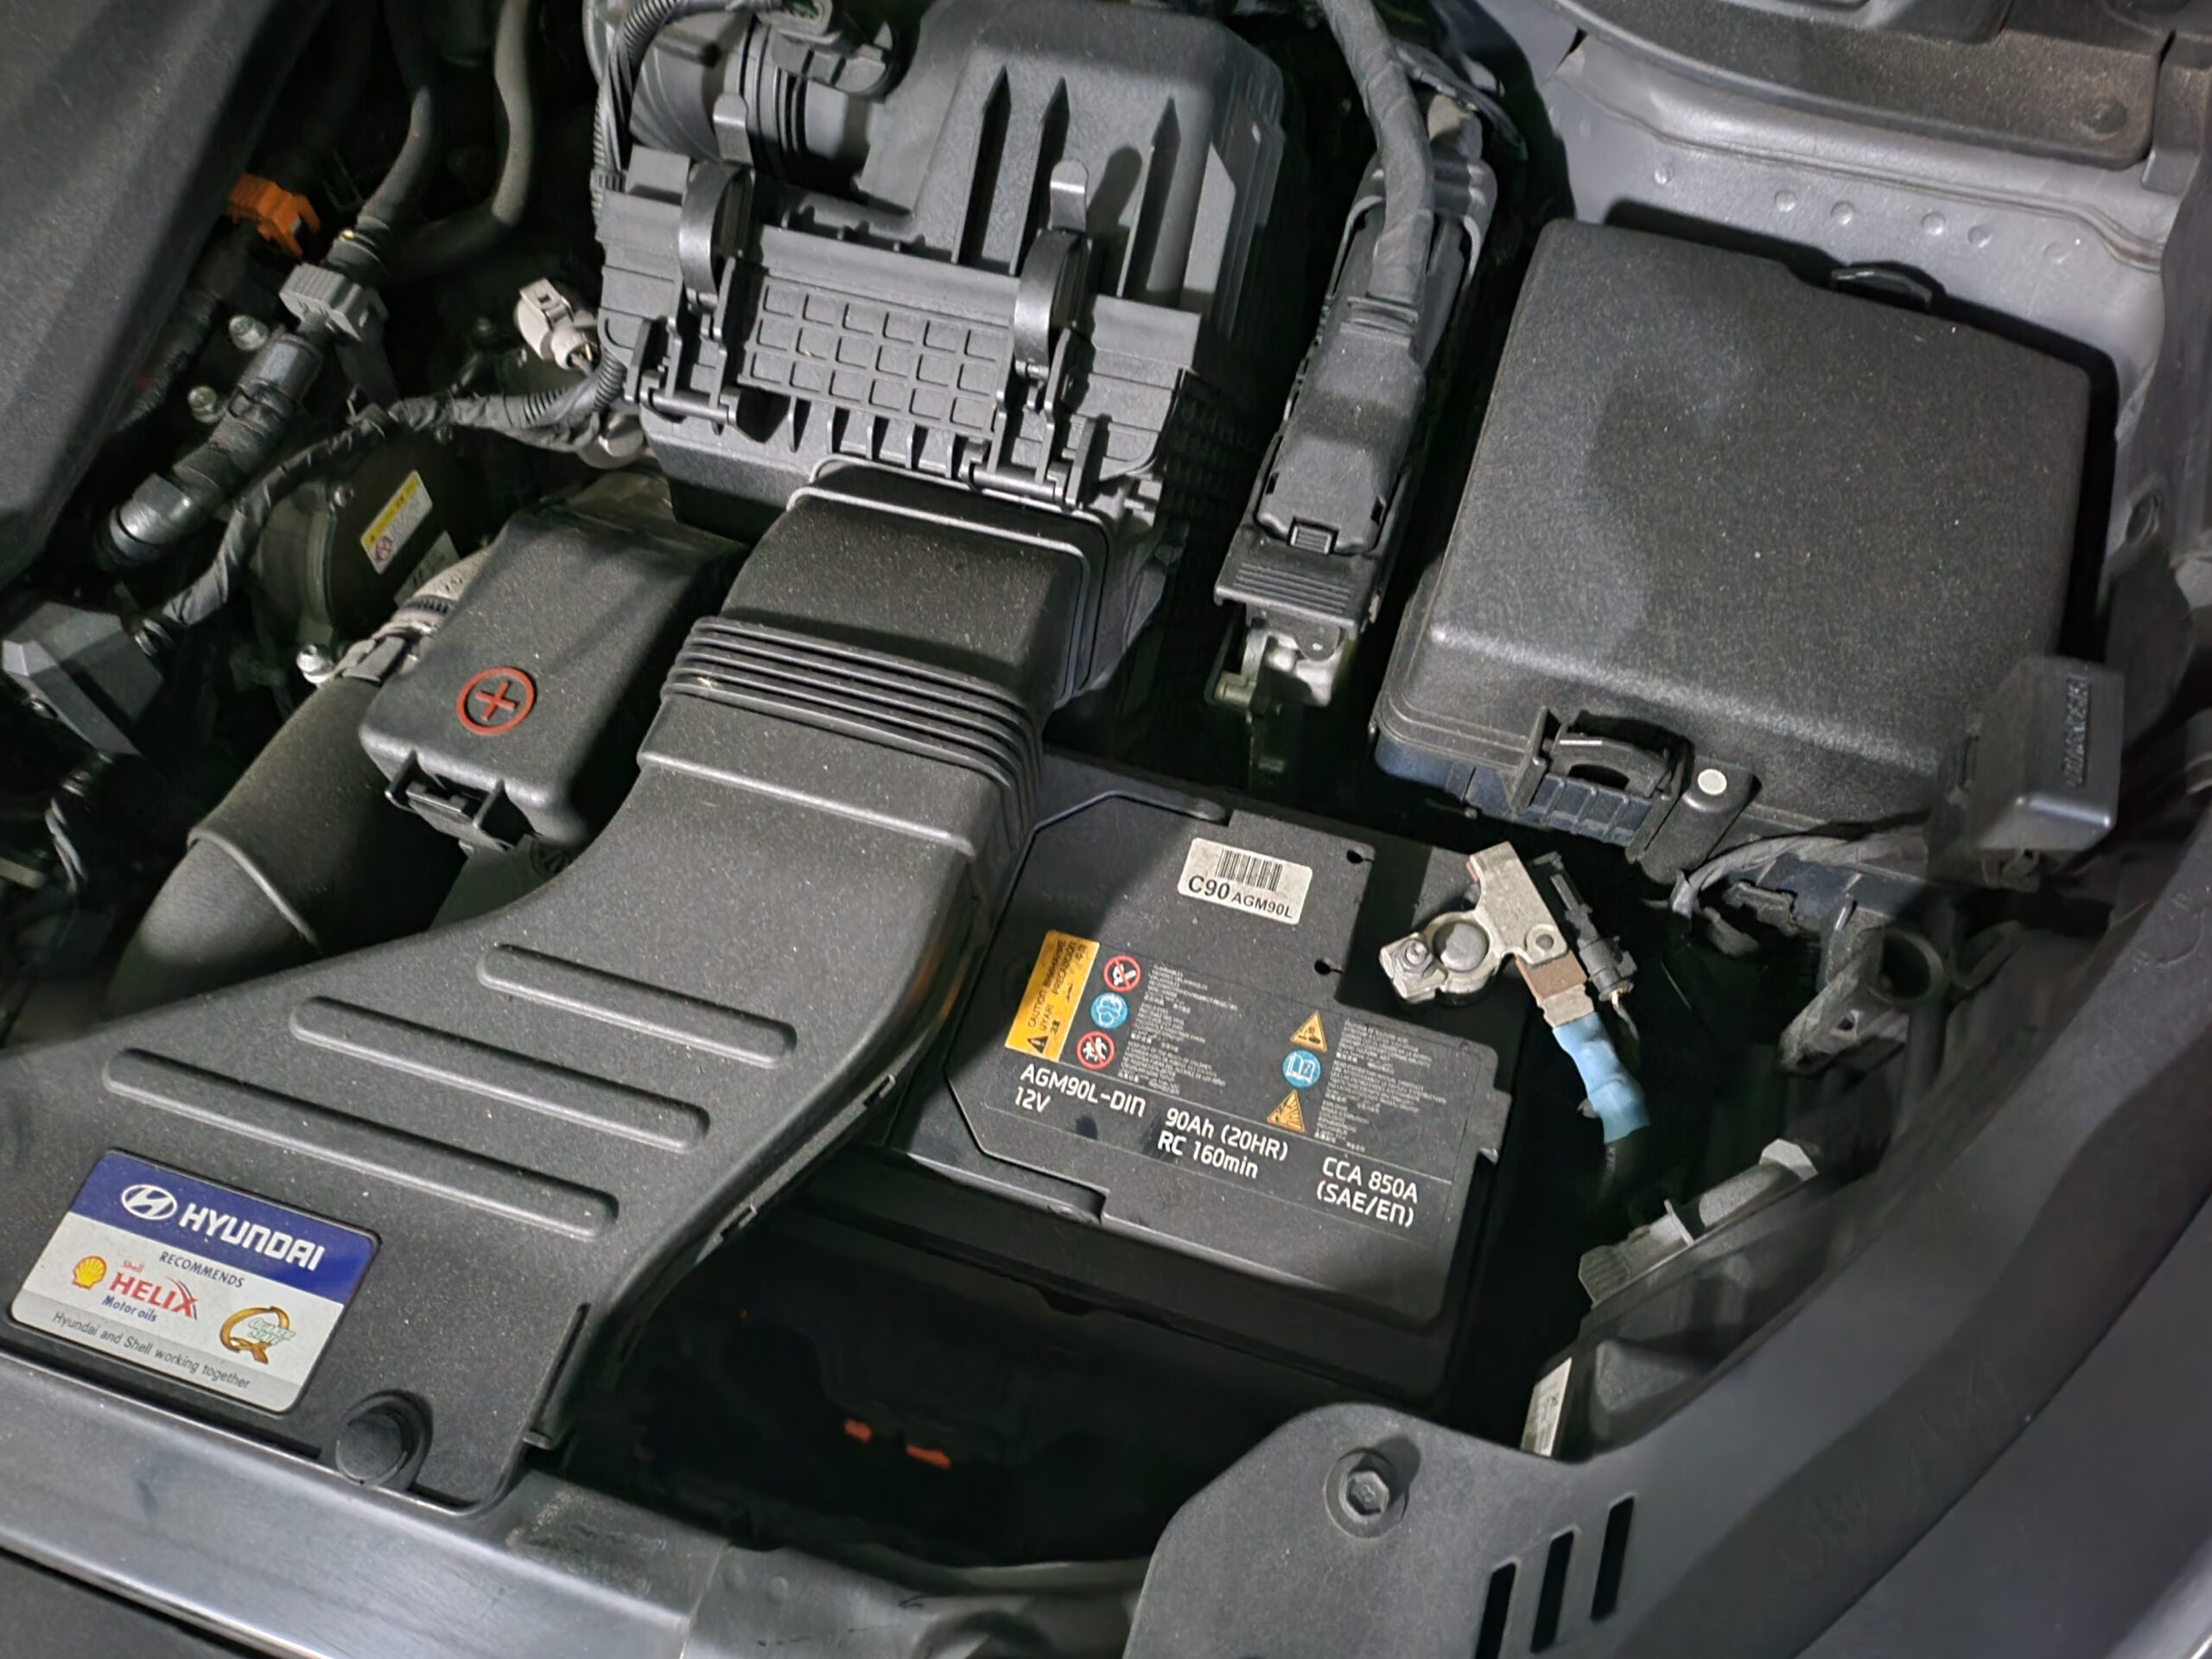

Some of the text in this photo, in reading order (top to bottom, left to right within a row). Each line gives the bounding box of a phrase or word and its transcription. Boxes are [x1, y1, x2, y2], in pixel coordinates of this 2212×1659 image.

[1188, 874, 1294, 919] C90 AGM90L
[1014, 1086, 1051, 1113] 12V
[1157, 1129, 1259, 1179] RC 160min
[1164, 1107, 1214, 1139] 90Ah
[1220, 1122, 1288, 1161] (20HR)
[1322, 1156, 1418, 1205] CCA 850A
[179, 1203, 326, 1271] HYUNDAI
[122, 1260, 145, 1274] Shell
[159, 1251, 245, 1288] RECOMMENDS
[101, 1295, 157, 1323] Motor oils
[109, 1272, 198, 1319] HELIX
[53, 1311, 251, 1389] Hyundai and Shell working together
